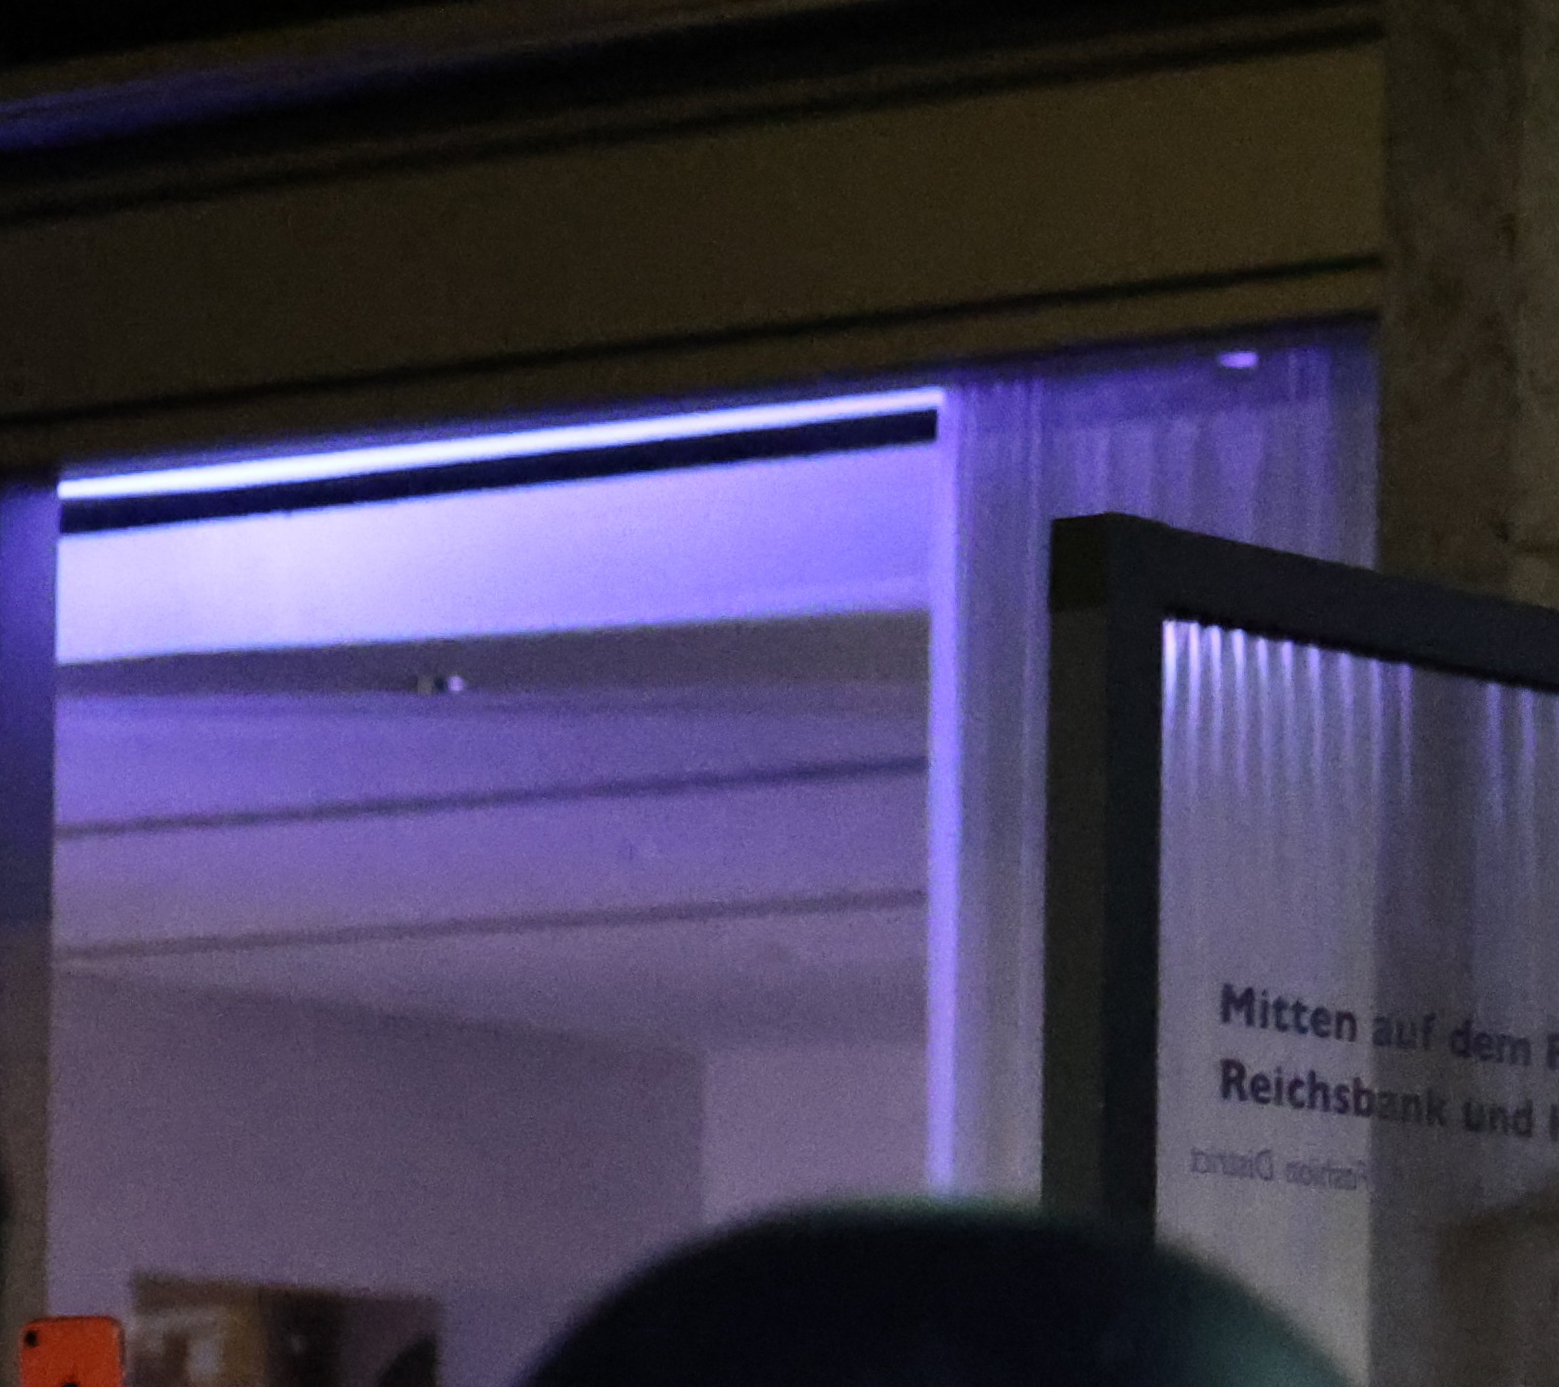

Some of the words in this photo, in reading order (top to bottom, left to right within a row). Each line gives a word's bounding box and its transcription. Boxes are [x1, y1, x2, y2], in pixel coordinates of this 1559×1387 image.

[1220, 983, 1358, 1043] Mitten
[1373, 1008, 1441, 1051] auf
[1450, 1018, 1532, 1068] dem
[1219, 1057, 1447, 1128] Reichsbank
[1461, 1098, 1534, 1138] und
